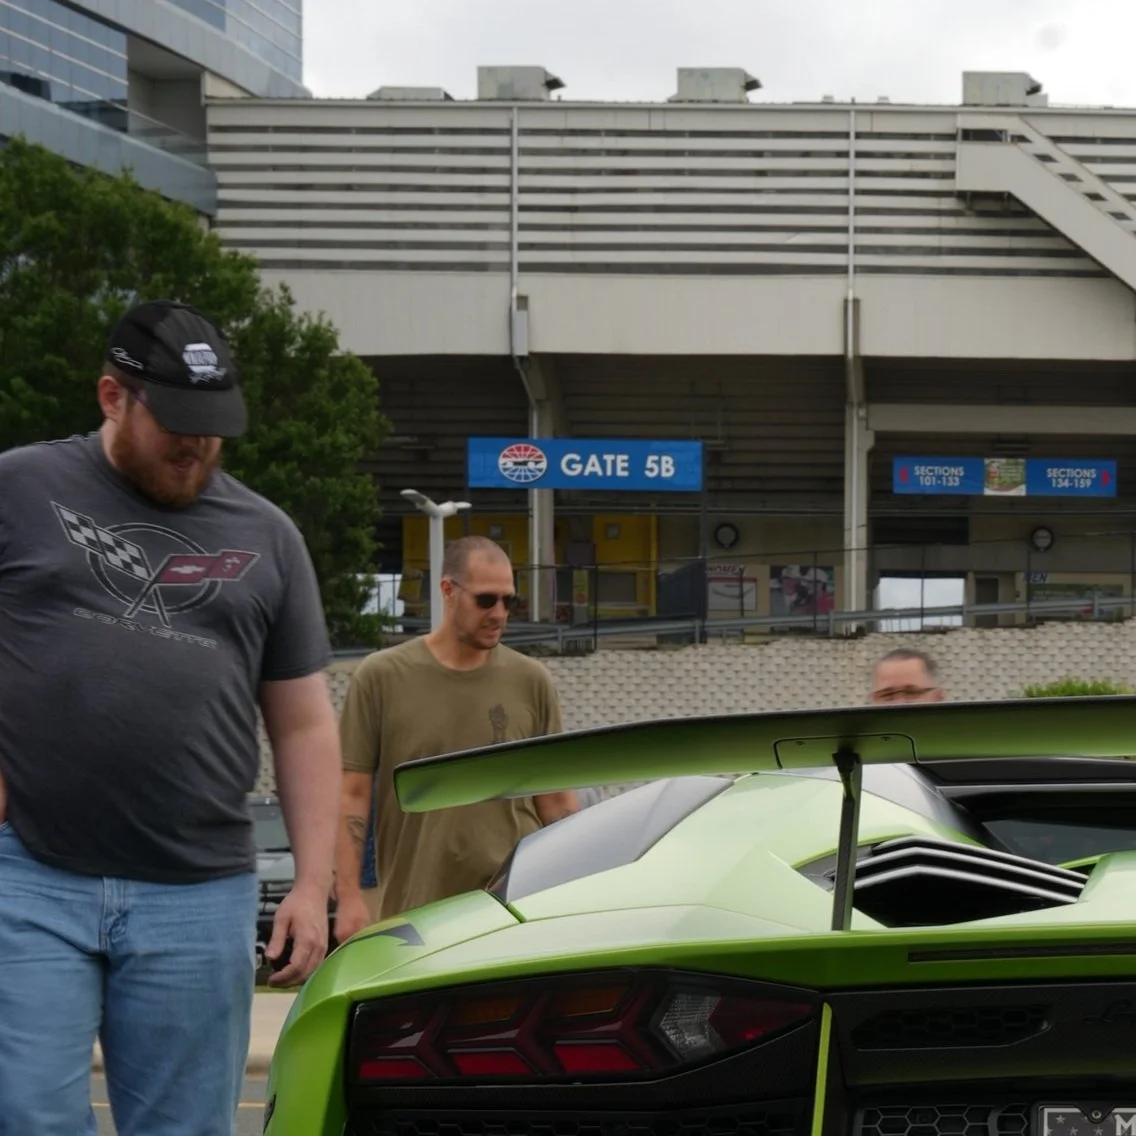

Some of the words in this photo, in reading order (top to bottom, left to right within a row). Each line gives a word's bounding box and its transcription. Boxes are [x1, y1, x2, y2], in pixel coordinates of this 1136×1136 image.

[560, 453, 630, 477] GATE
[644, 454, 676, 479] 5B
[914, 465, 965, 477] SECTIONS
[1046, 468, 1097, 479] SECTIONS
[919, 476, 960, 487] 101-133
[1051, 478, 1092, 488] 134-159
[72, 607, 218, 650] CORVETTE
